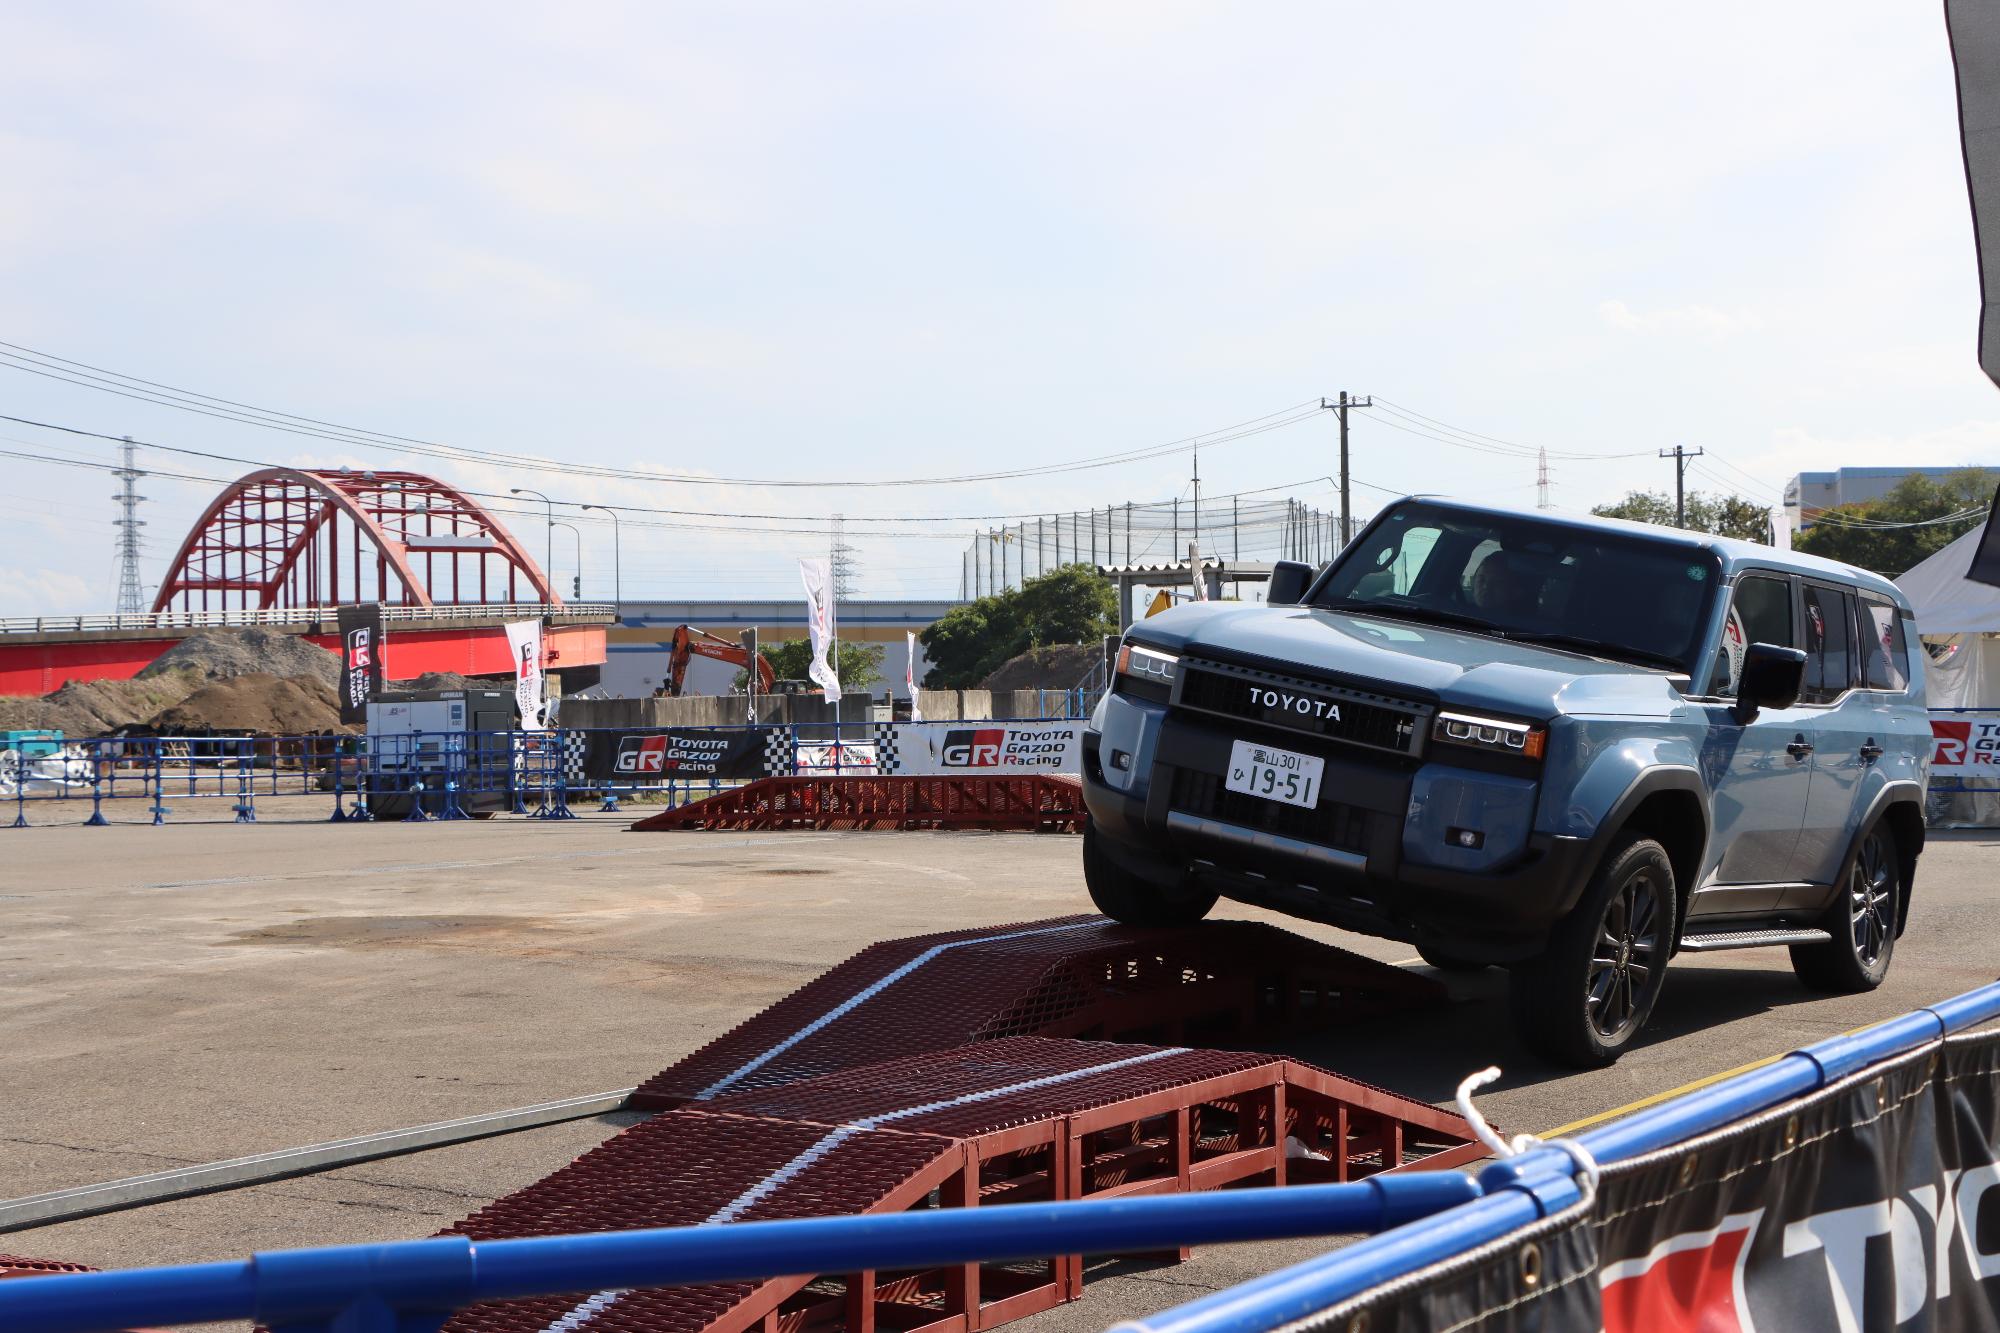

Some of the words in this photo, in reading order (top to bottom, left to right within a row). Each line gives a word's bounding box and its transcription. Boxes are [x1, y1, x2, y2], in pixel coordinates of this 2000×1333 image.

[1250, 687, 1341, 722] TOYOTA
[1008, 730, 1074, 741] TOYOTA
[670, 736, 728, 749] TOYOTA
[1006, 743, 1066, 753] GAZOO
[619, 750, 662, 770] GR
[667, 748, 721, 760] GAZOO
[943, 744, 999, 765] GR
[666, 760, 717, 773] Racing
[1003, 755, 1062, 767] Racing
[1233, 768, 1245, 781] ひ
[1249, 765, 1311, 803] 19-51
